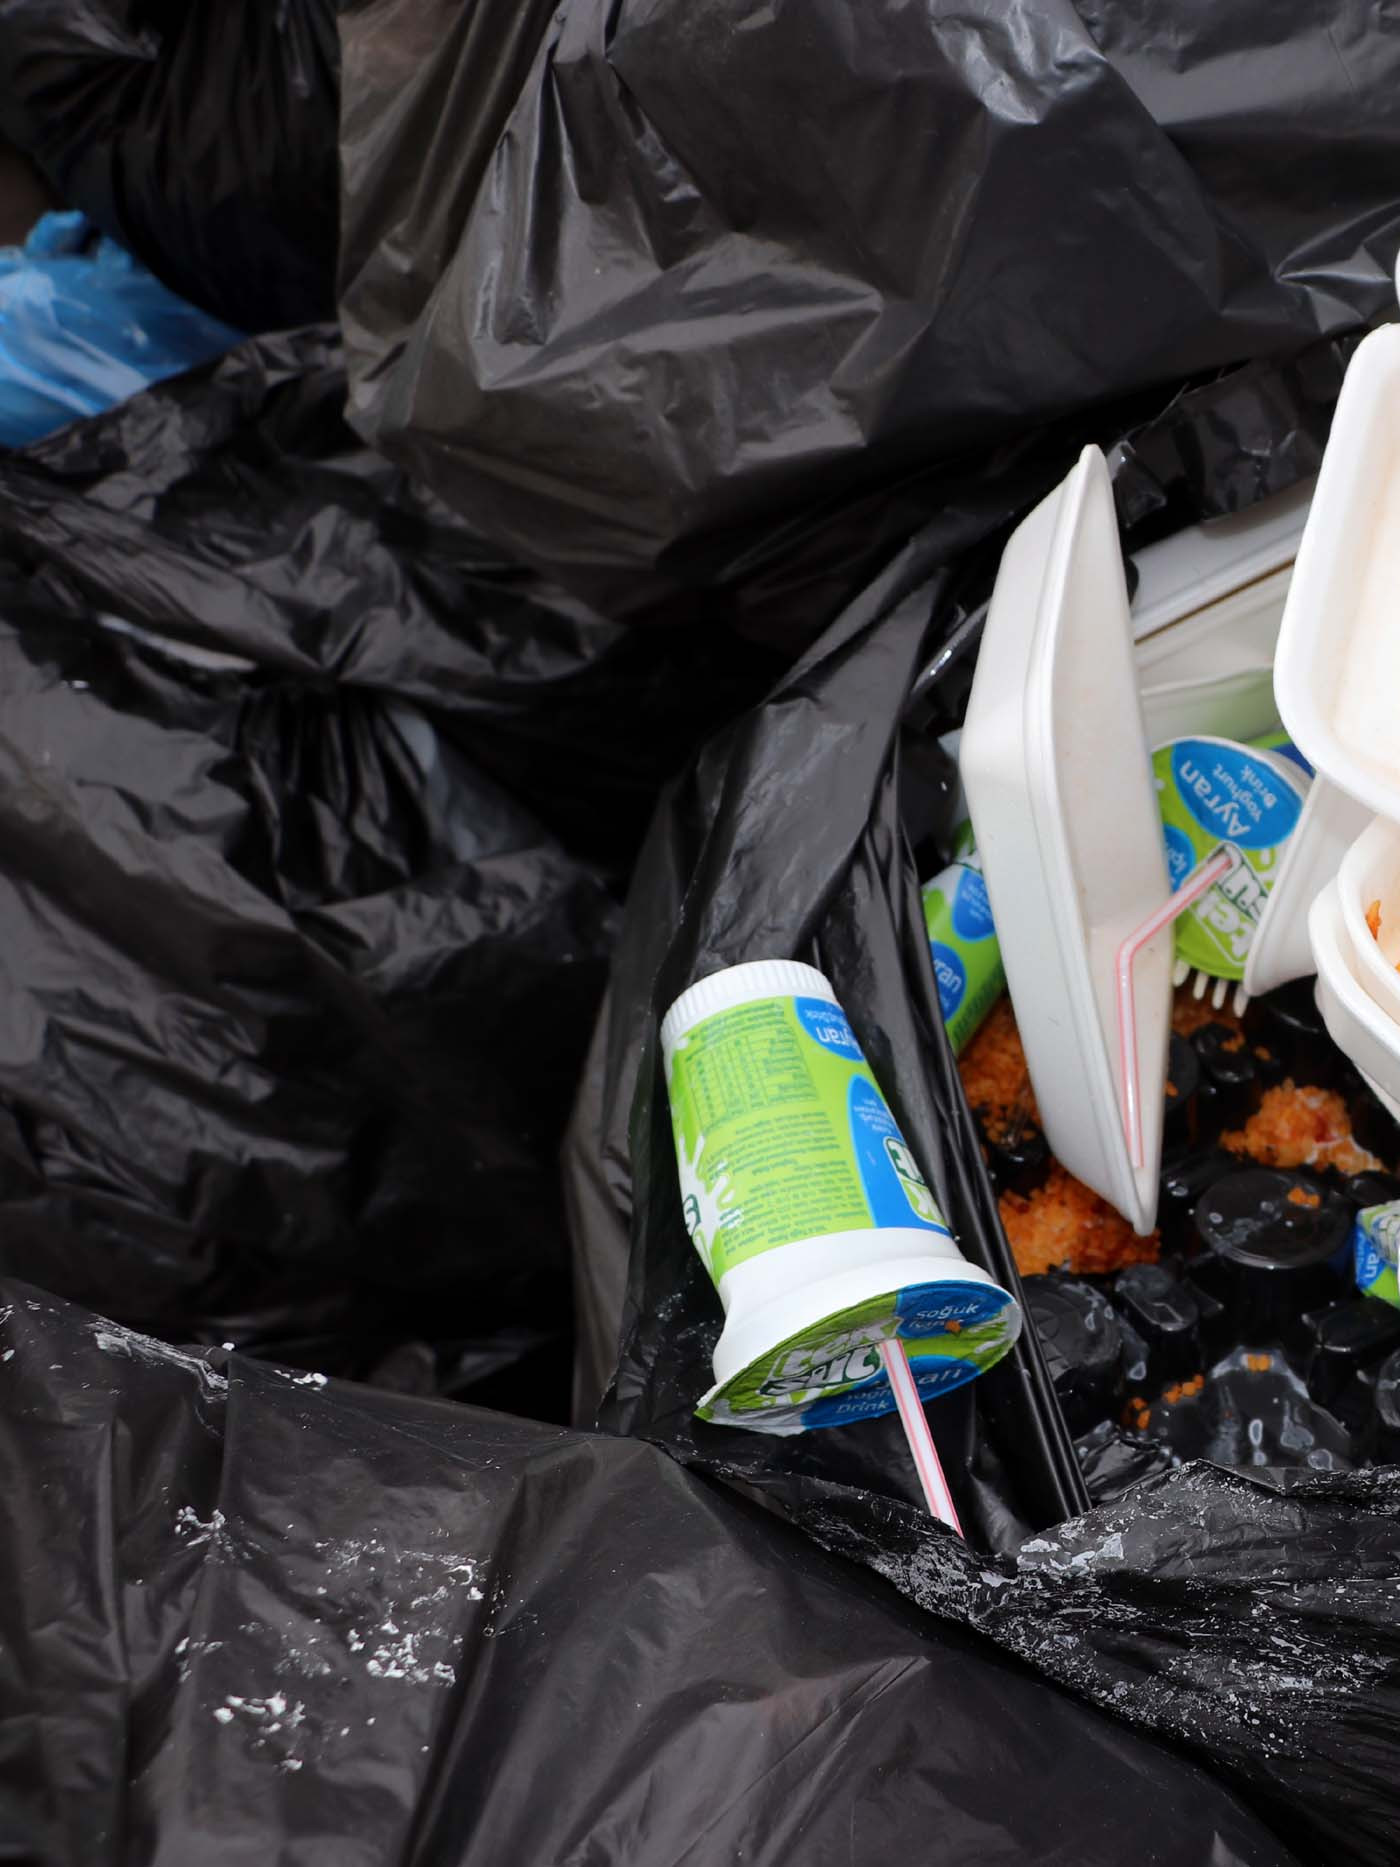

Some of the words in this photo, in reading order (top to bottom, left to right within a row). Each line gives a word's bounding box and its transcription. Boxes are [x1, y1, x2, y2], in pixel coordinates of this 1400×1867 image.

[1179, 760, 1251, 838] Ayran
[1212, 763, 1263, 823] Yoghurt
[1240, 765, 1278, 809] Drink
[916, 1303, 979, 1320] soğuk
